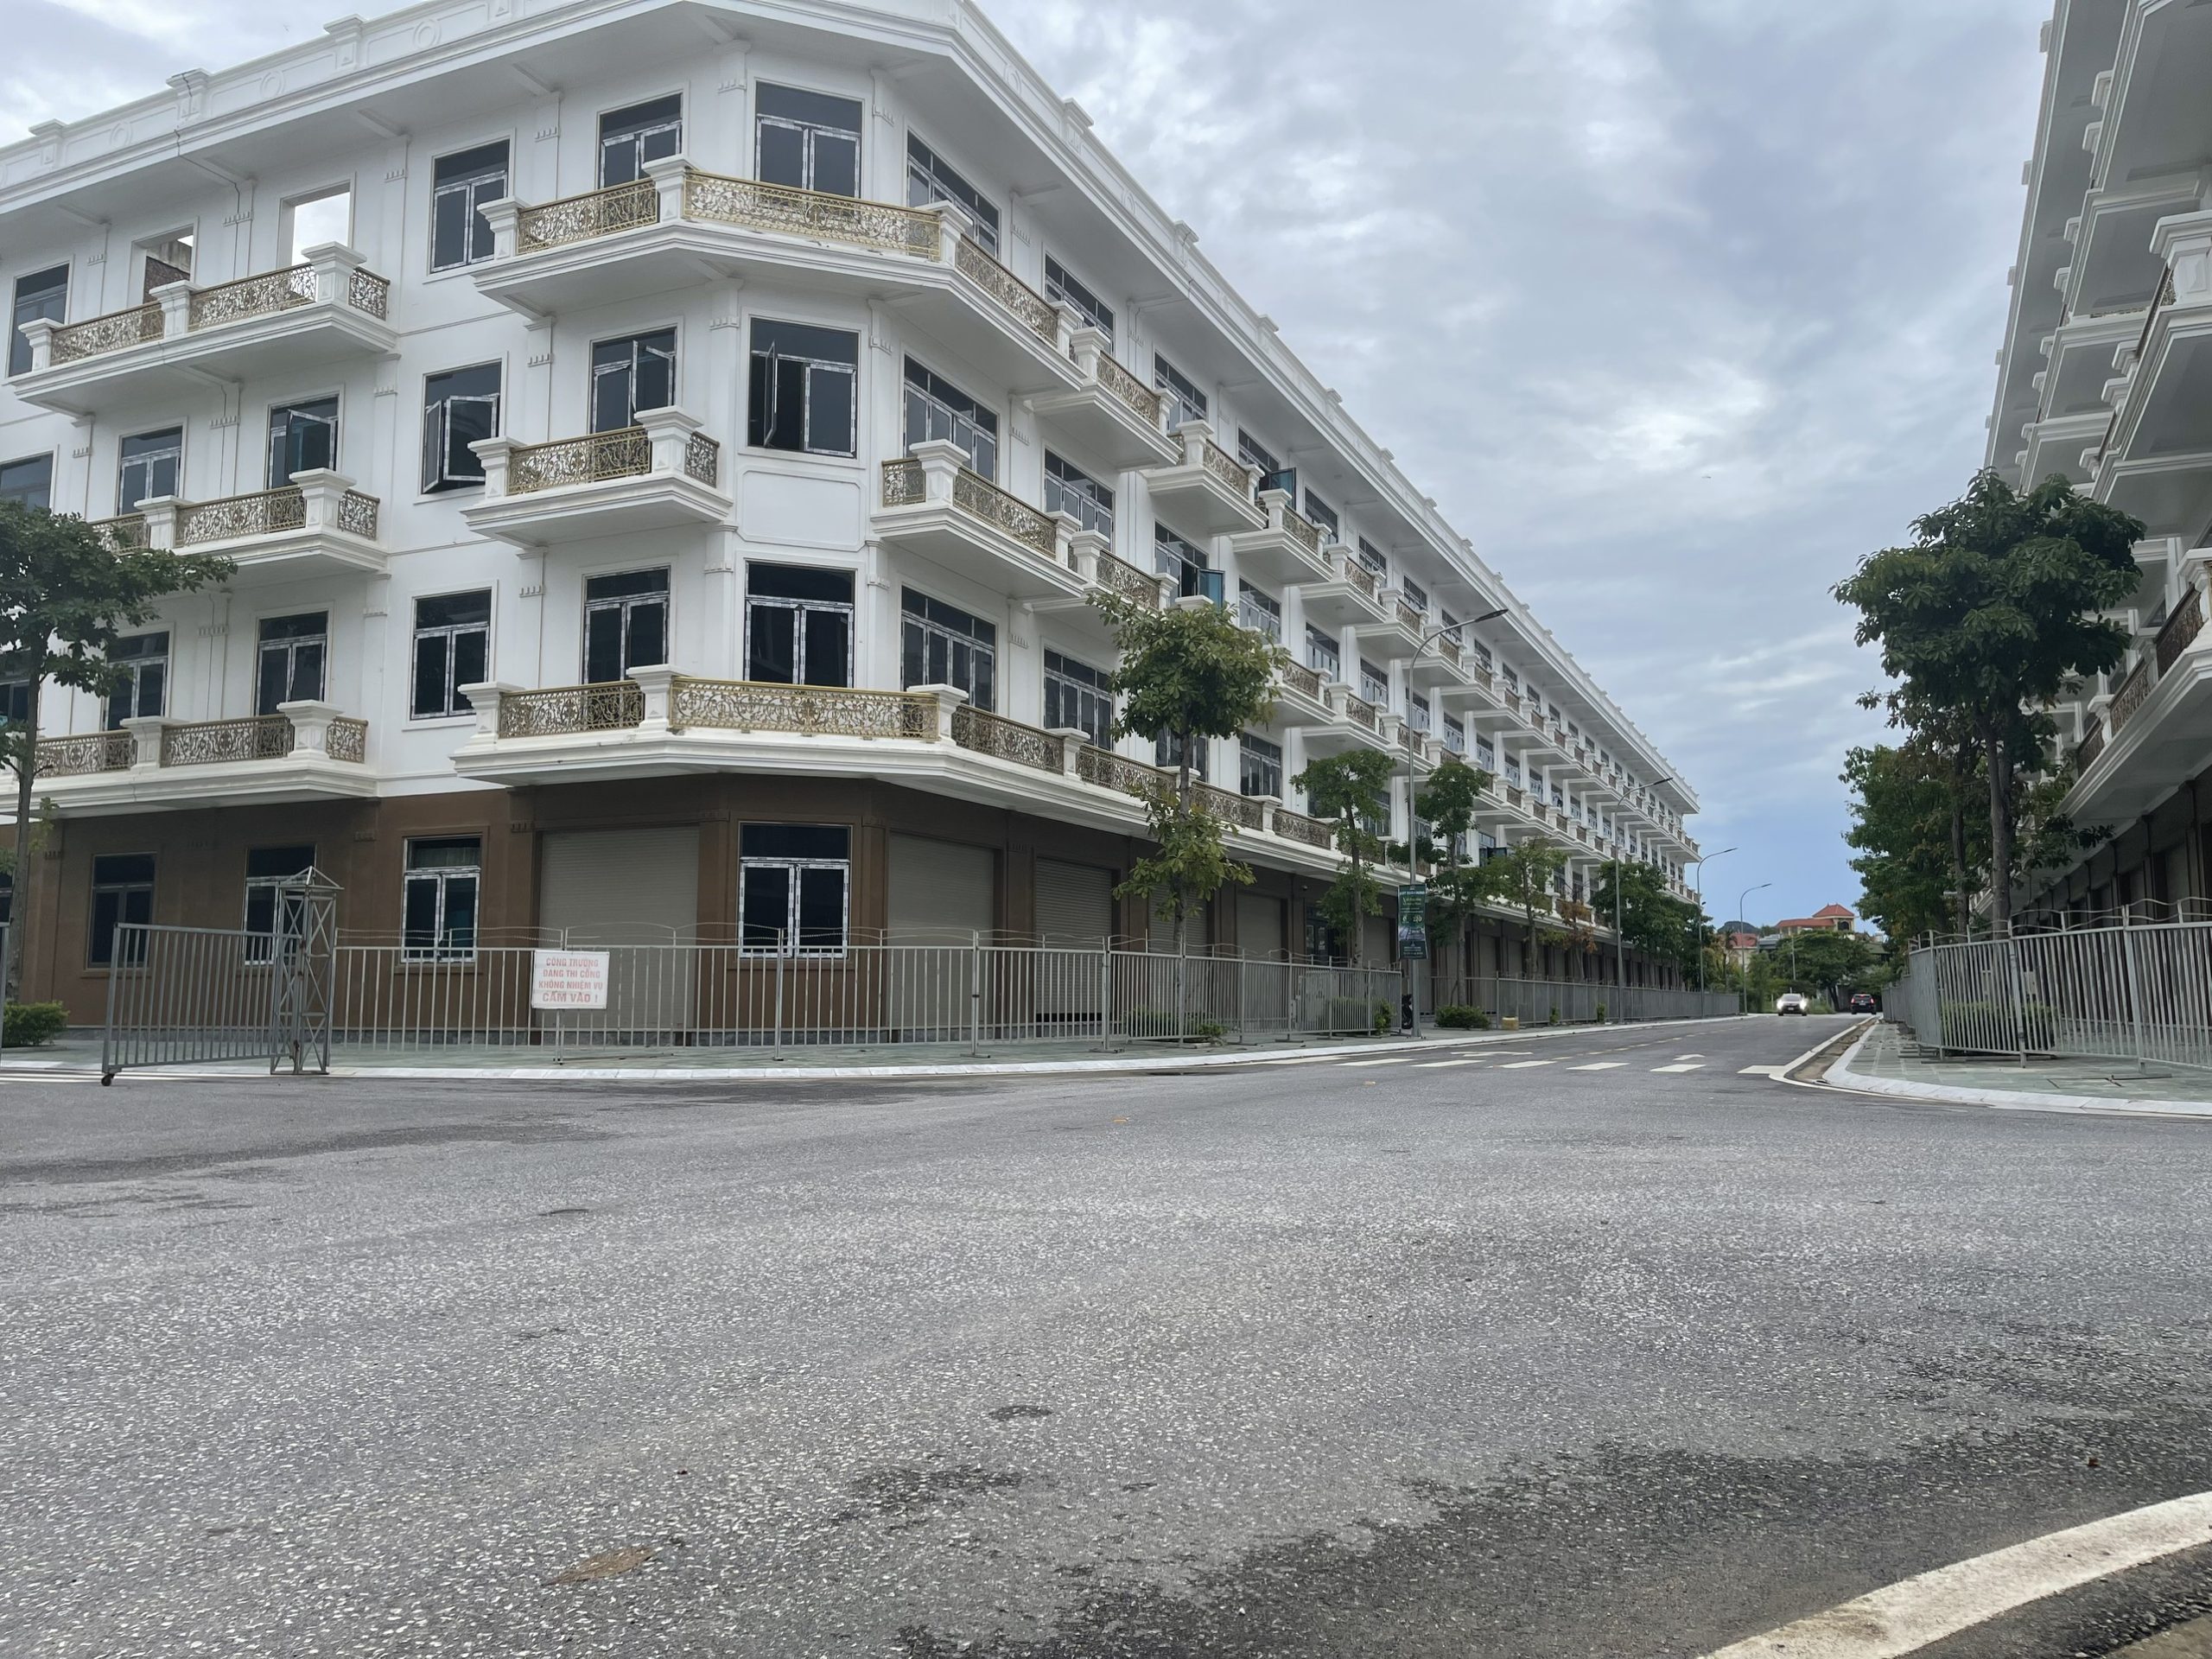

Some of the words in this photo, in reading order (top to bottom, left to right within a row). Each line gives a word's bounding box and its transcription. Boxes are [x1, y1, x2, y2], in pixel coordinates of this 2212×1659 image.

[580, 968, 601, 978] CÔNG
[538, 980, 564, 988] KHÔNG
[570, 992, 591, 1002] VÀO
